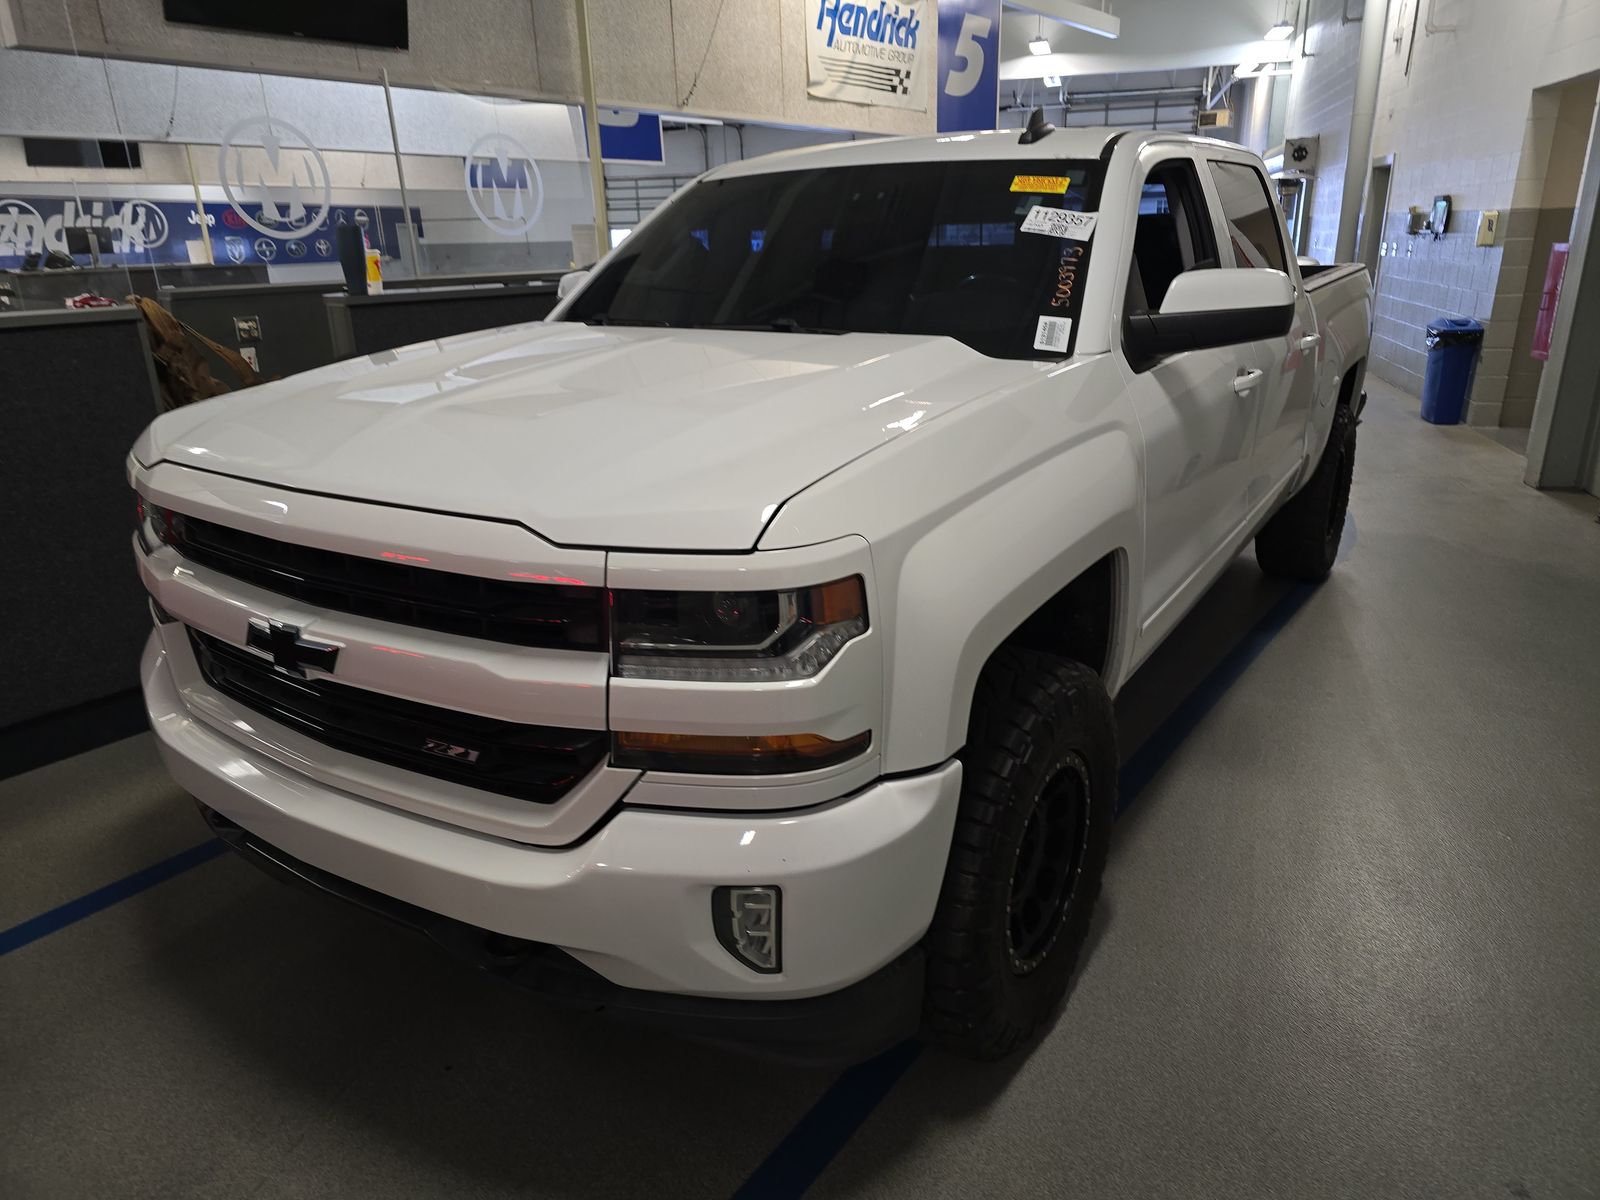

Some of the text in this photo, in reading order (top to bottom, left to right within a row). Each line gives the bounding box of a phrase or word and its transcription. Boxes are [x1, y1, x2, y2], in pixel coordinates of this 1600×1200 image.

[817, 0, 920, 49] Hendrick
[833, 39, 915, 65] AUTOMOTIVE GROUP
[944, 12, 992, 97] 5
[1034, 209, 1095, 227] 1129357
